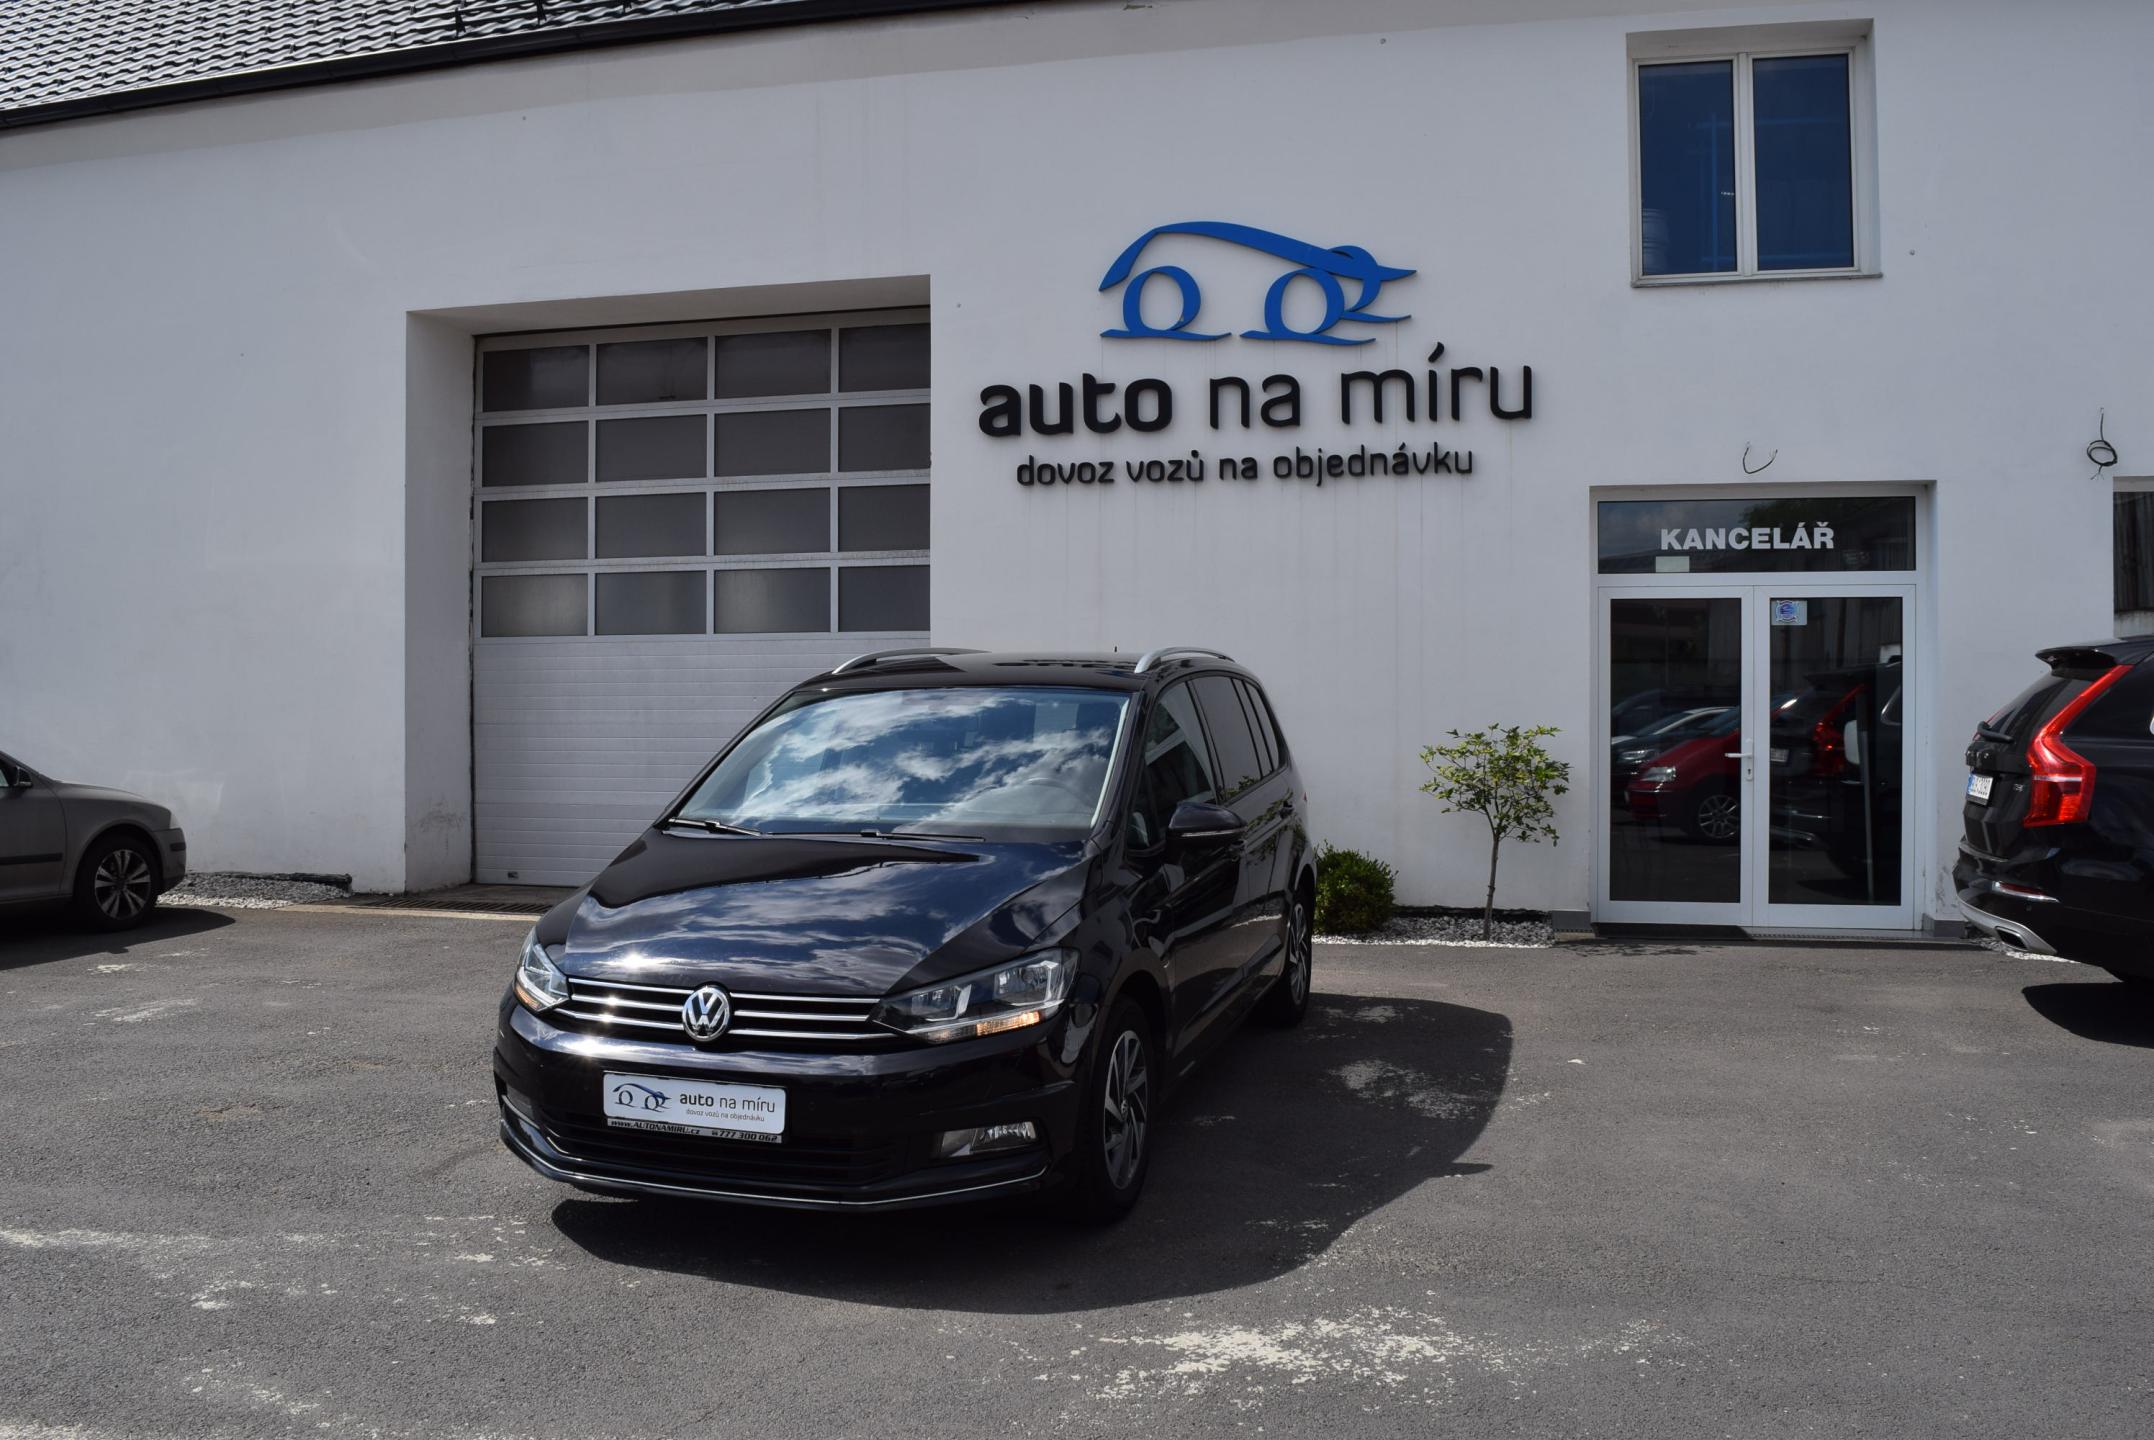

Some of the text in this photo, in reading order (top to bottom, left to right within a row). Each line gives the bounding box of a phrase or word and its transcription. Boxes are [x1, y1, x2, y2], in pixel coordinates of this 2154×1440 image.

[979, 341, 1533, 438] auto na míru
[1016, 441, 1474, 488] dovoz vozů na objednávku
[1660, 519, 1834, 550] KANCELÁŘ
[680, 1093, 776, 1113] auto na míru
[686, 1108, 704, 1116] dovoz
[729, 1112, 765, 1122] objednávku
[719, 1130, 737, 1138] 777
[738, 1132, 757, 1141] 300
[758, 1134, 778, 1142] 062
